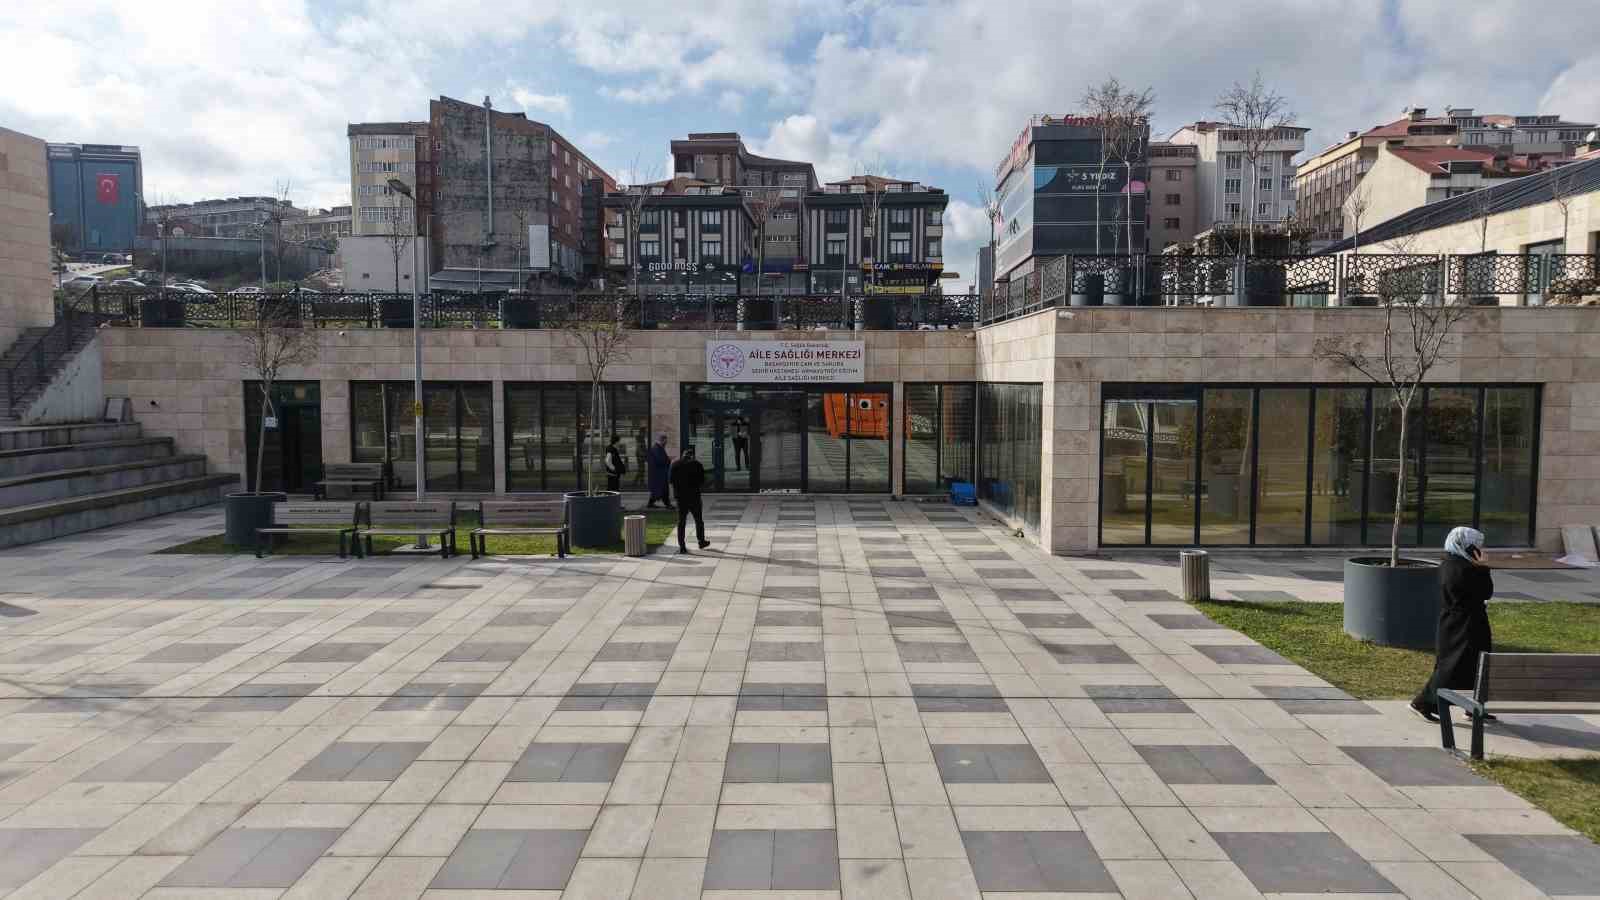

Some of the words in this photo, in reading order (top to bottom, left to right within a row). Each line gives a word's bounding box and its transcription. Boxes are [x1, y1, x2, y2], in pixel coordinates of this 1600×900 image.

[749, 348, 771, 359] AİLE
[774, 348, 814, 359] SAĞLIĞI
[816, 348, 861, 359] MERKEZİ
